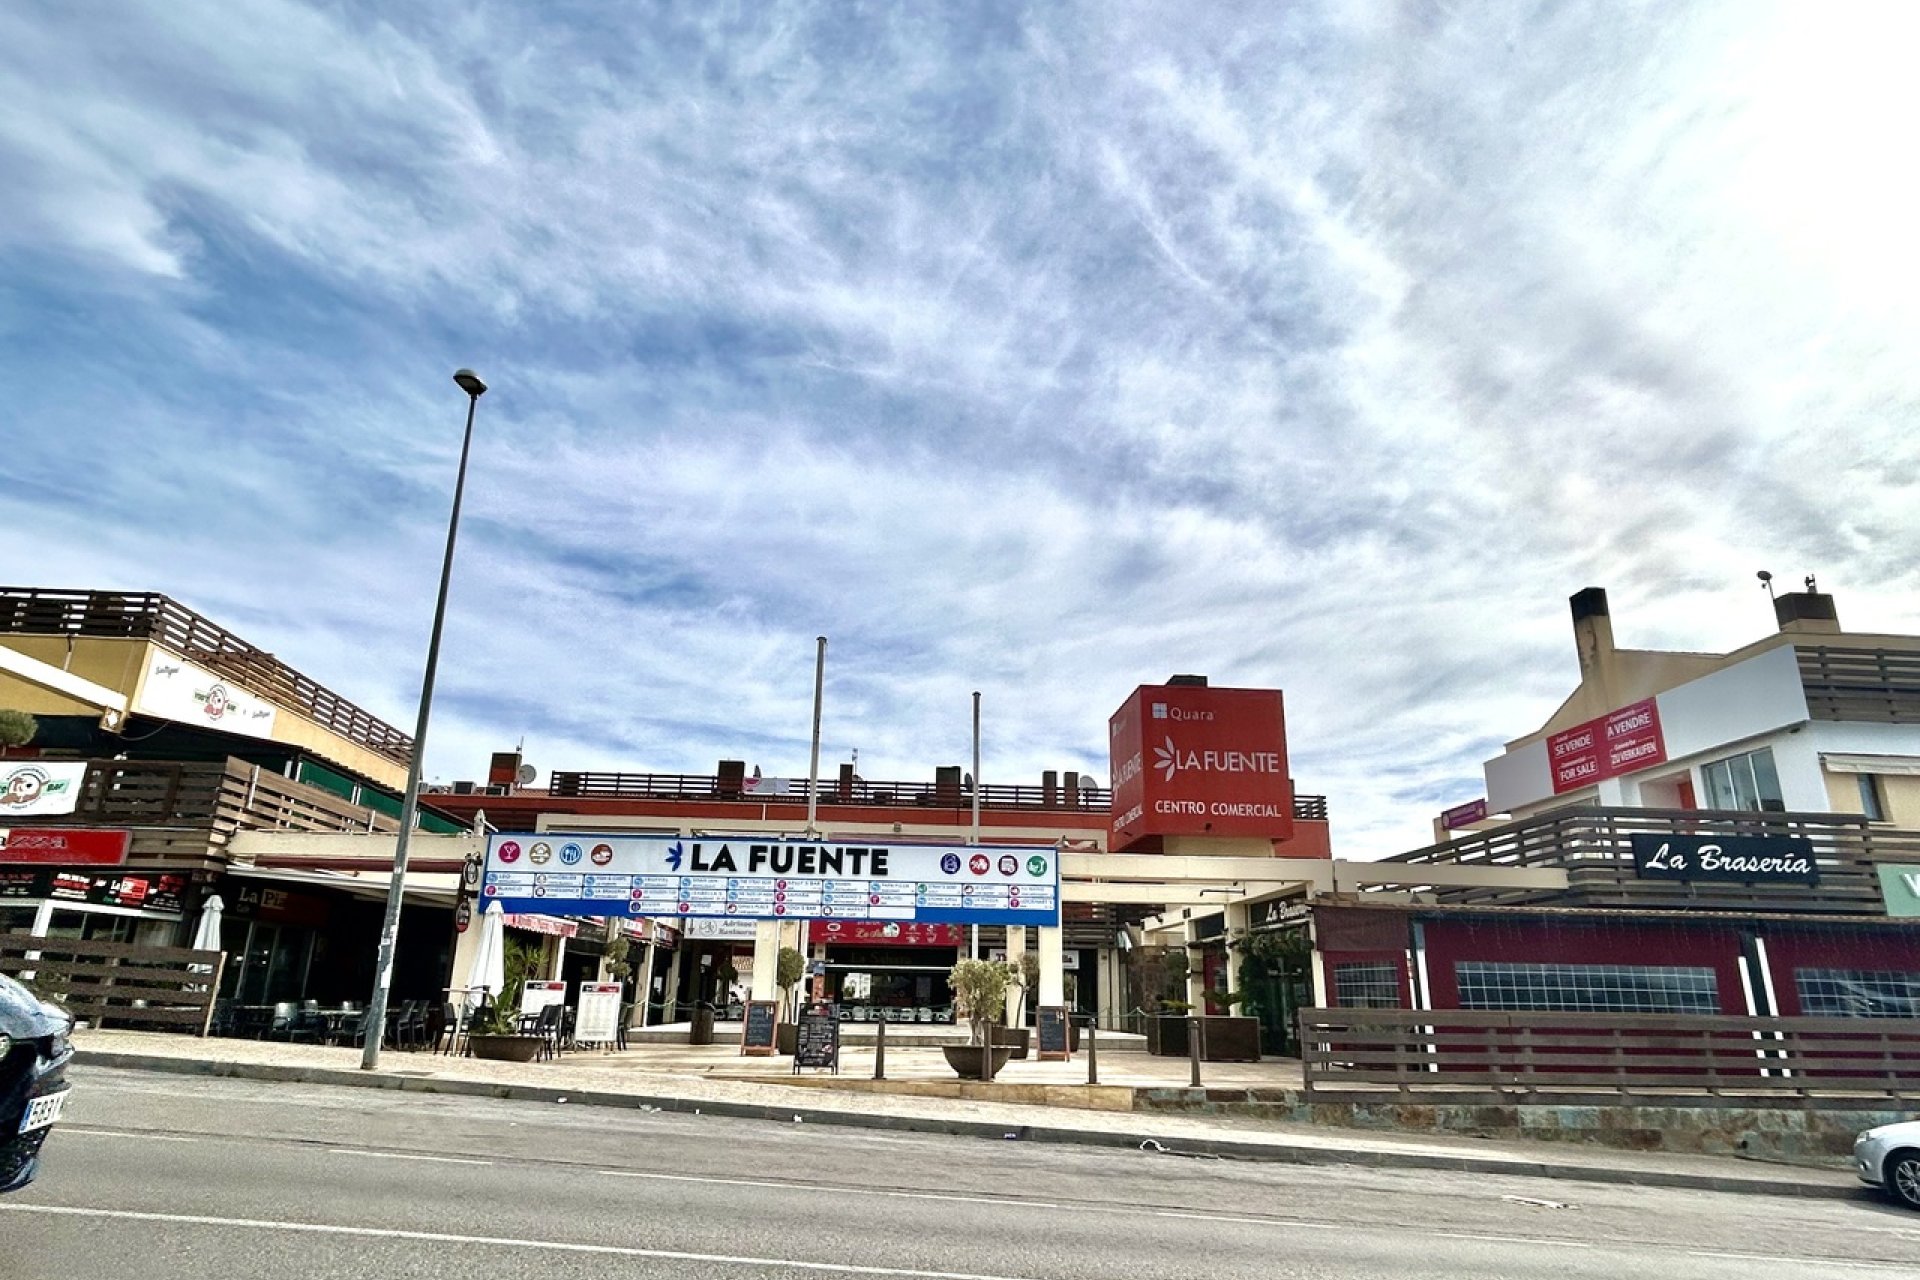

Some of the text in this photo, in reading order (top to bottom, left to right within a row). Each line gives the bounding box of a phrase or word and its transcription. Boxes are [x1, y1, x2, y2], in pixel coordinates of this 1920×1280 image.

[1170, 707, 1214, 721] Quara
[1615, 713, 1650, 734] VENDRE
[1555, 734, 1591, 756] SE VENDE
[1176, 750, 1279, 773] LA FUENTE
[1560, 761, 1596, 782] FOR SALE
[1155, 800, 1282, 818] CENTRO COMERCIAL
[690, 843, 889, 876] LA FUENTE
[1645, 843, 1812, 874] La Brasería
